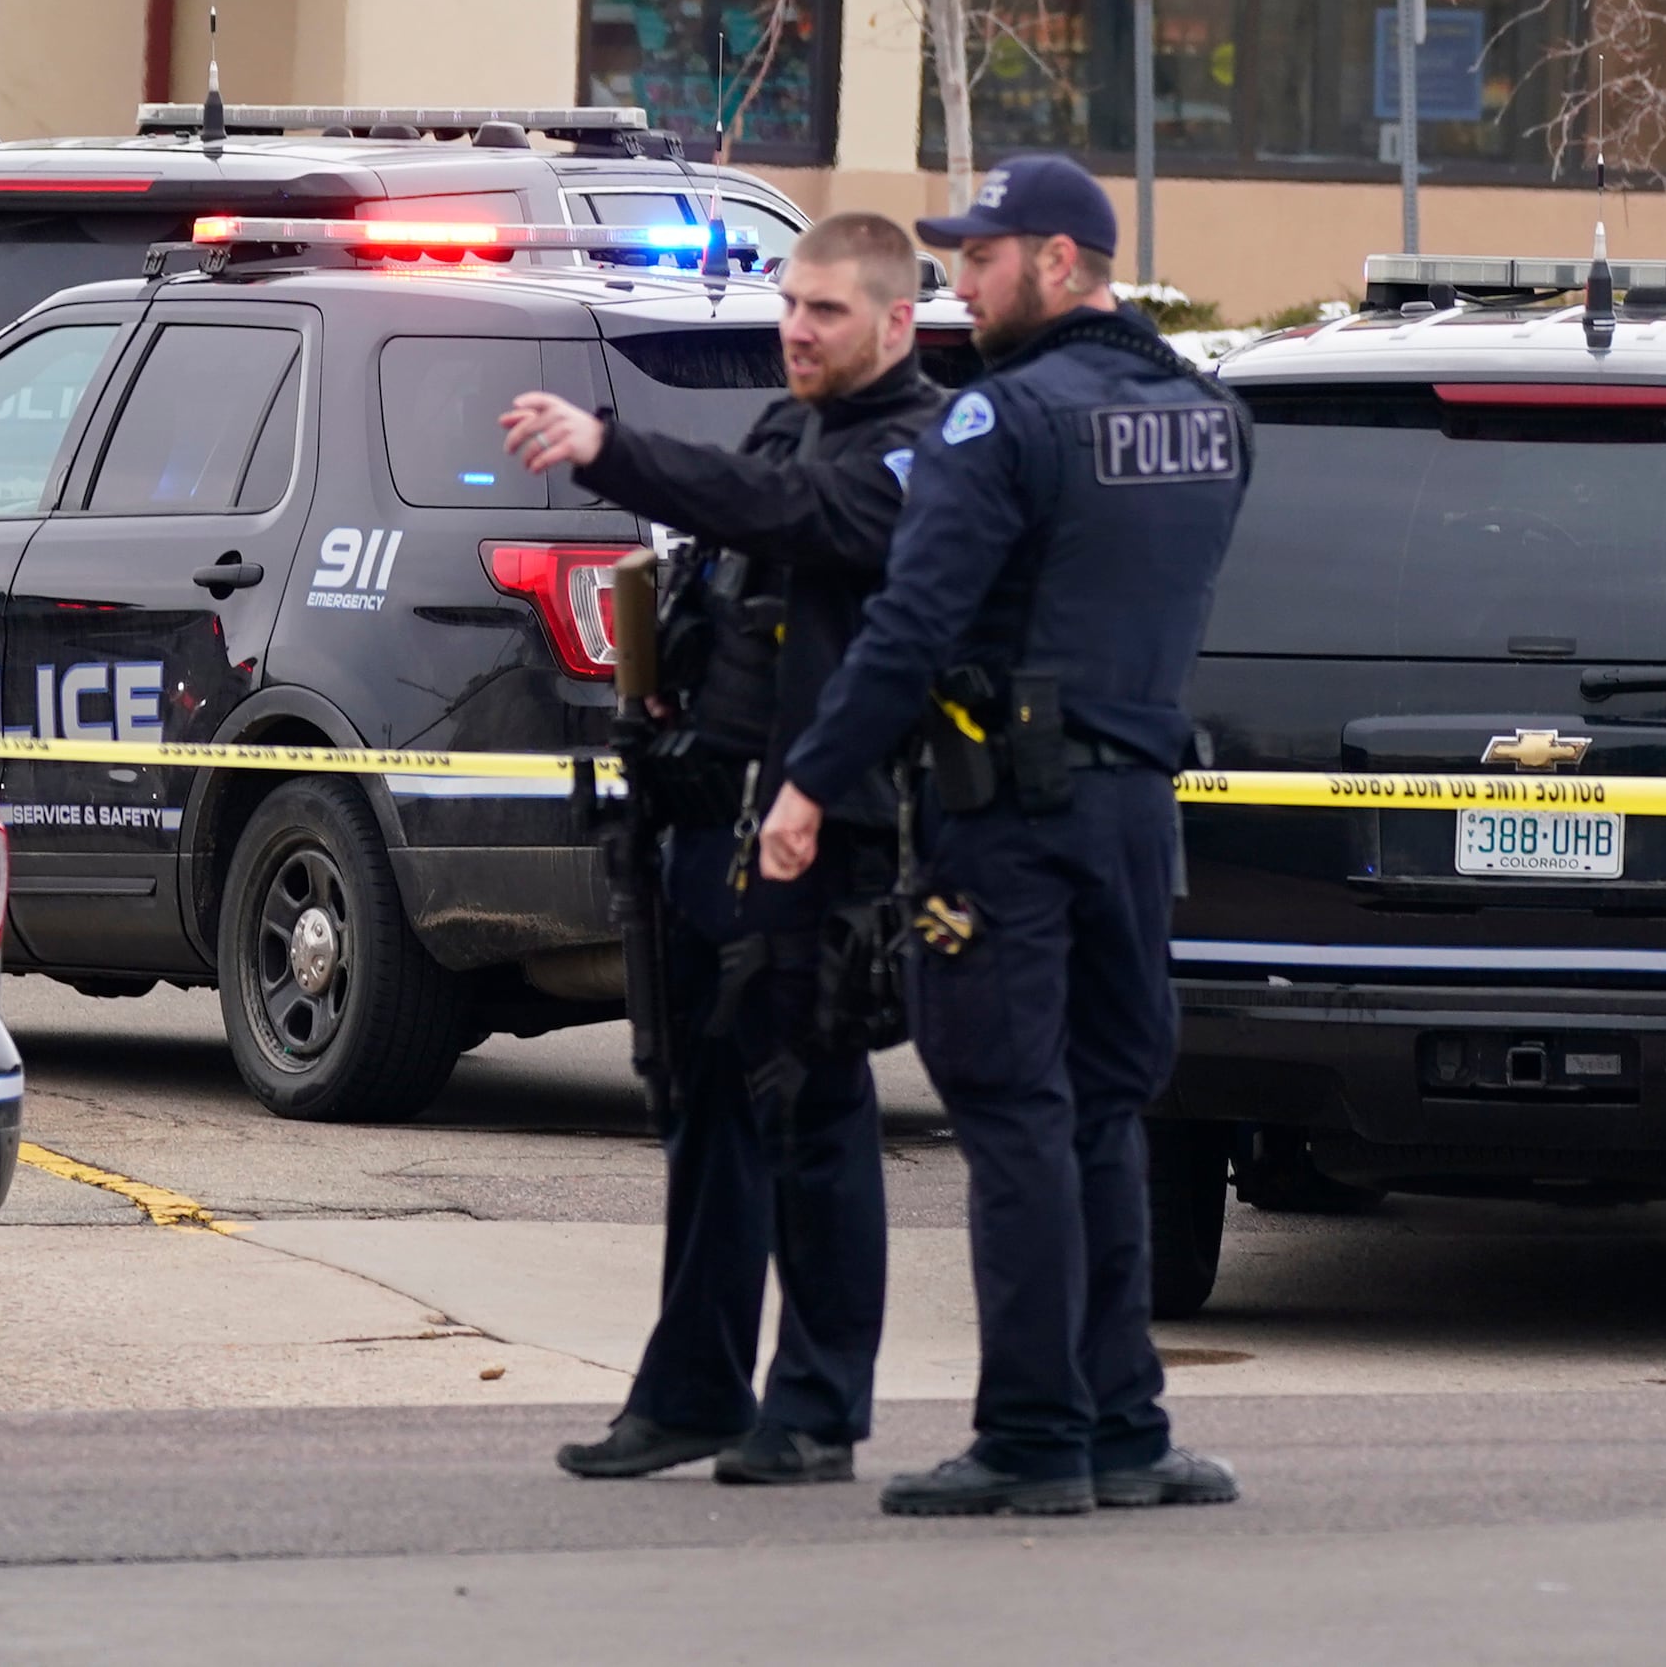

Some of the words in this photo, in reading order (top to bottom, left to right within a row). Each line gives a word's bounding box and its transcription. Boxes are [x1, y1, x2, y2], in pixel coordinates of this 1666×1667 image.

[1108, 409, 1230, 477] POLICE
[311, 527, 403, 592] 911
[306, 590, 385, 612] EMERGENCY
[13, 804, 80, 825] SERVICE
[84, 806, 96, 825] &
[99, 806, 162, 828] SAFETY
[1500, 857, 1580, 870] COLORADO
